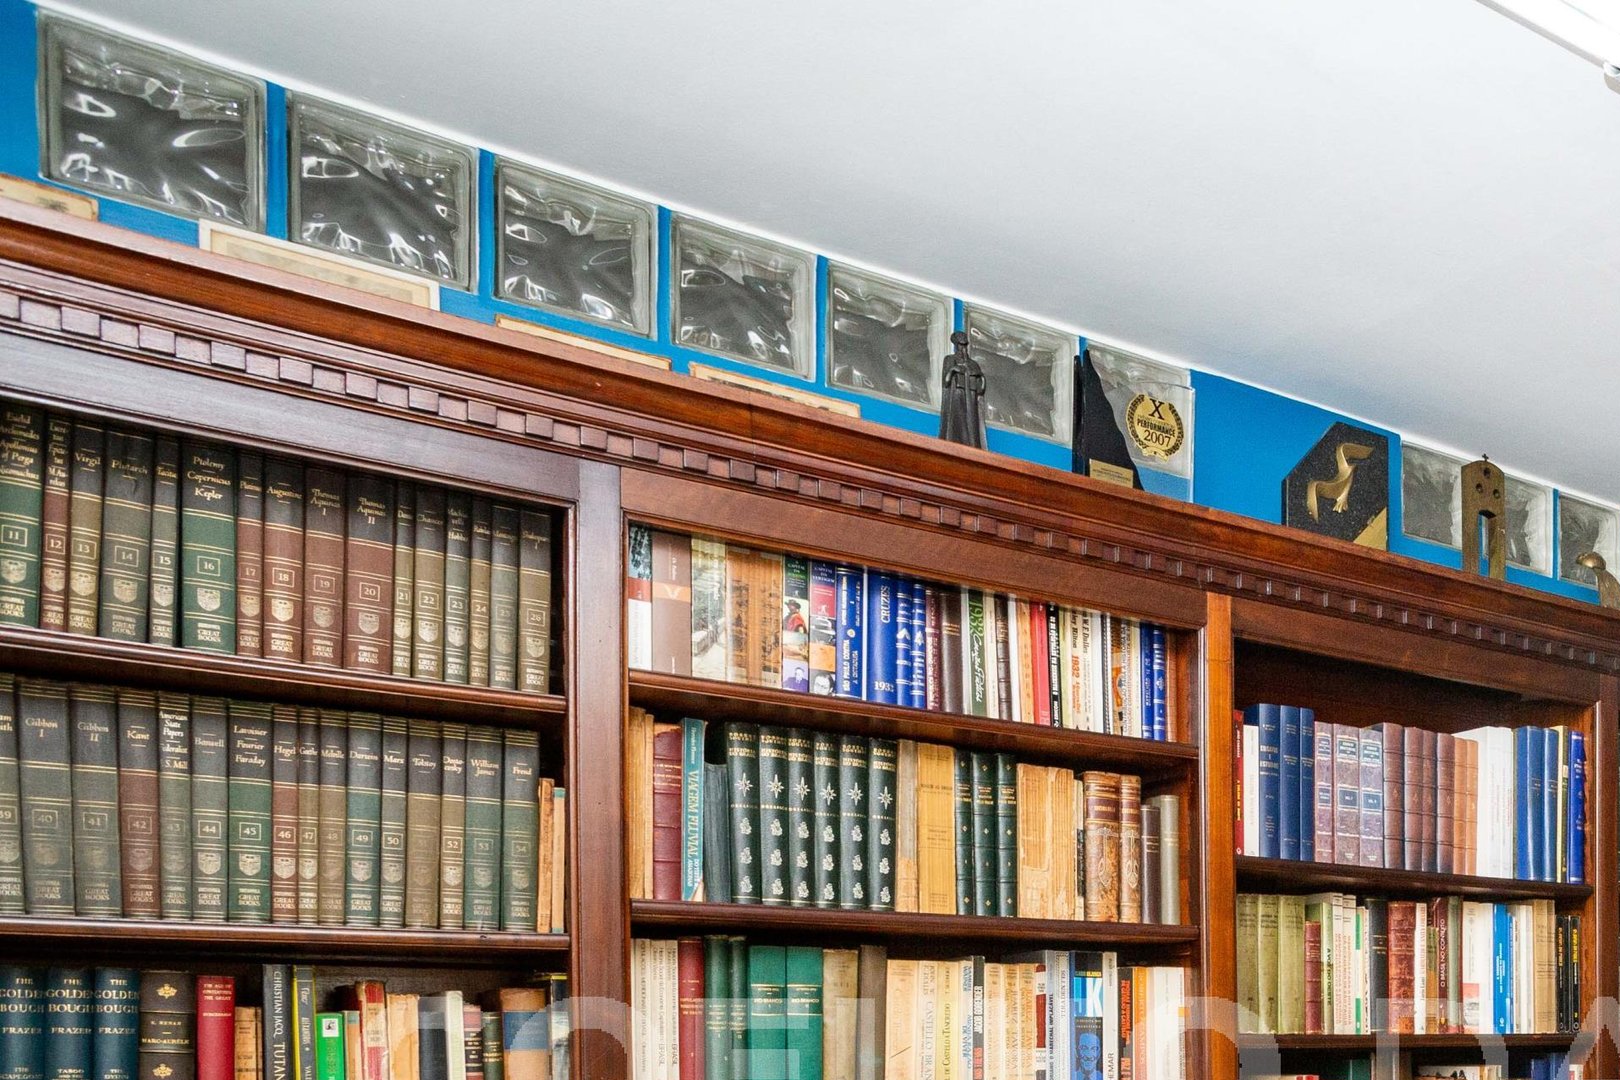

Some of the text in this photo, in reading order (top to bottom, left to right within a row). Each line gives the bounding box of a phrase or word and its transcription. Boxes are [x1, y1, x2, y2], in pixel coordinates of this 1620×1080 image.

[1137, 420, 1175, 437] PERFORMANCE
[1144, 430, 1171, 447] 2007
[75, 453, 101, 466] Virgil
[187, 471, 231, 485] Copernicus
[195, 488, 223, 500] Kepler
[880, 585, 890, 623] CRUZES
[25, 717, 58, 729] Gibbon
[77, 721, 109, 733] Gibbon
[127, 730, 149, 740] Kant
[163, 727, 184, 739] Papers
[274, 745, 296, 758] Hegel
[235, 754, 266, 767] Faraday
[687, 770, 699, 858] VIAGEM FLUVIAL
[273, 971, 283, 1013] CHRISTIAN
[1074, 977, 1102, 1017] JK
[273, 1015, 283, 1038] JACQ
